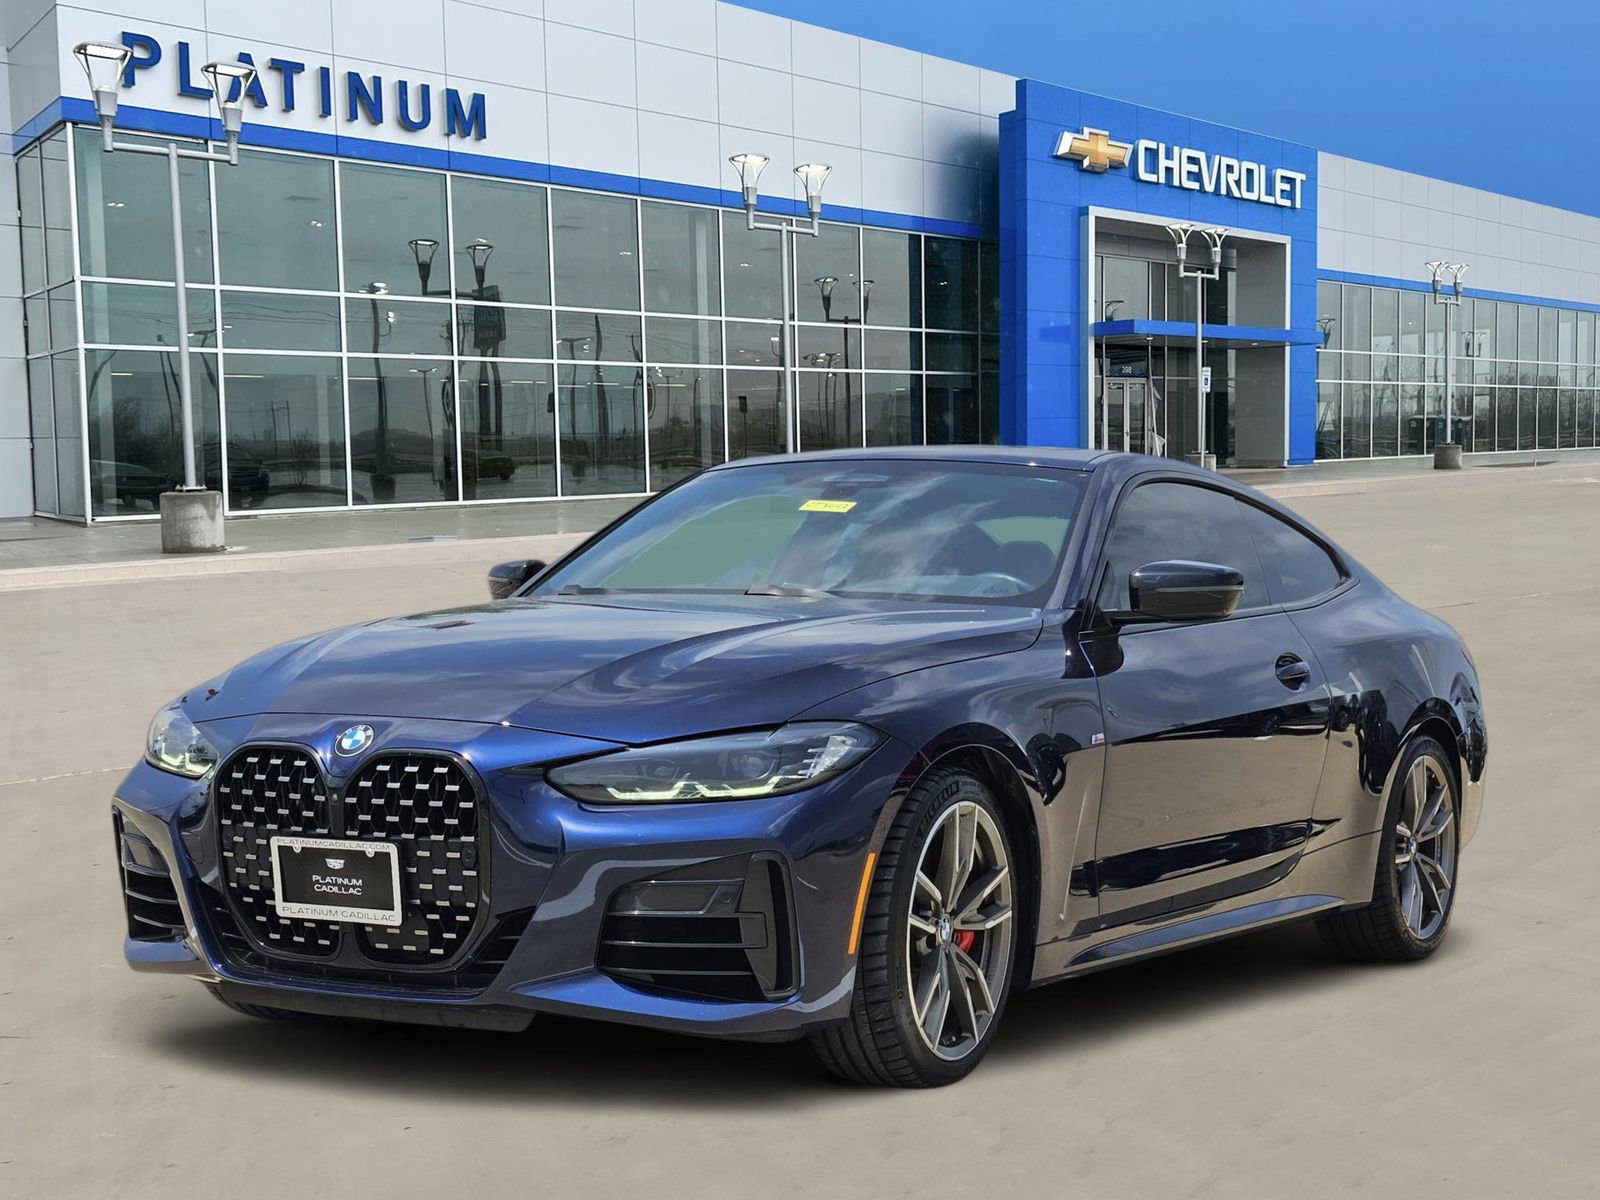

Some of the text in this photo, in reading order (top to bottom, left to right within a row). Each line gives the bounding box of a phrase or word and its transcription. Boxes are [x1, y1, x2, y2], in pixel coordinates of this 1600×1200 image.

[121, 31, 487, 140] PLATINUM
[1136, 139, 1306, 208] CHEVROLET
[312, 874, 362, 886] PLATINUM
[314, 884, 362, 895] CADILLAC
[282, 906, 396, 922] PLATINUM CADILLAC
